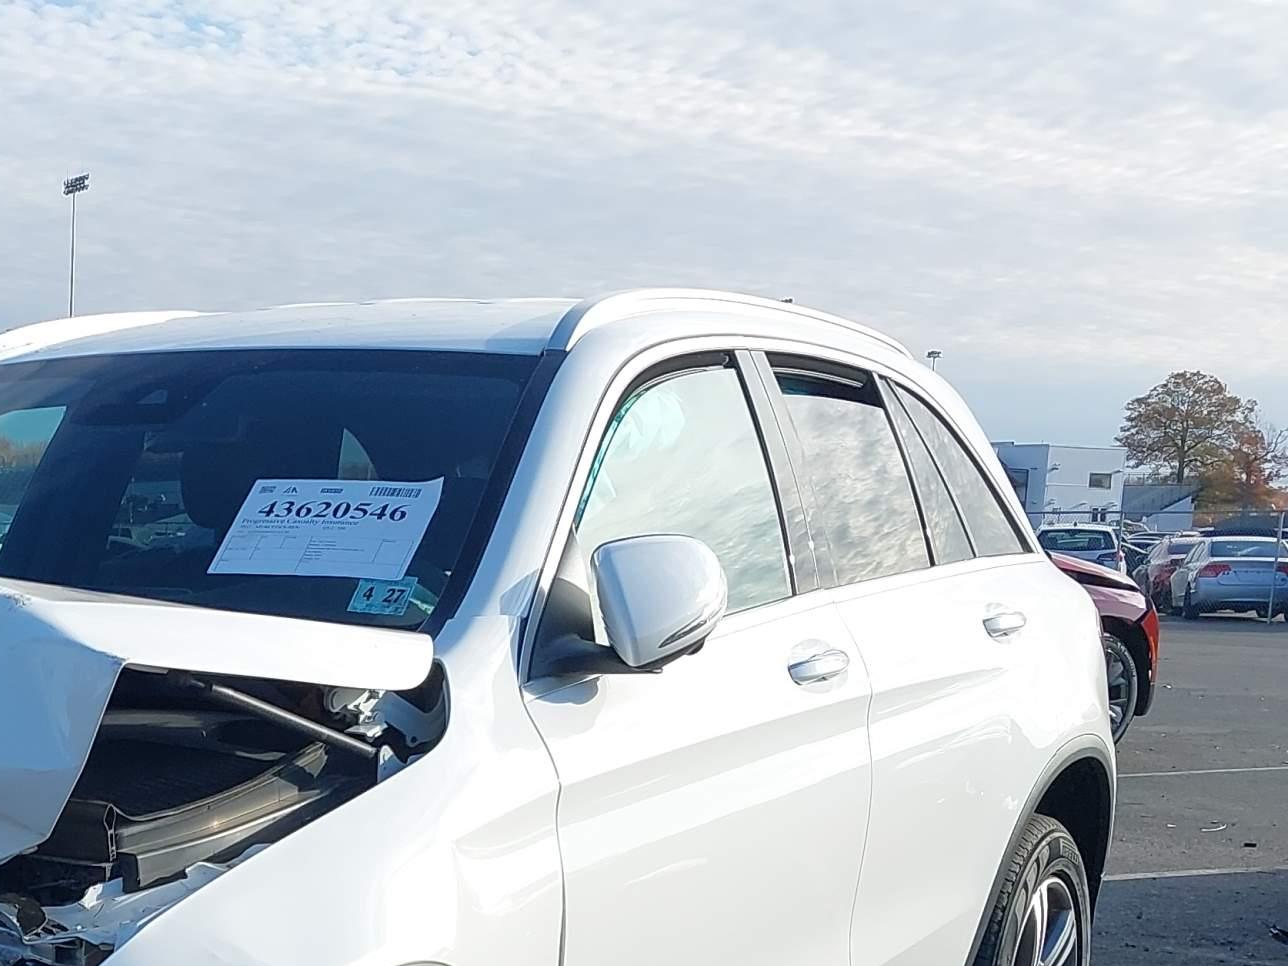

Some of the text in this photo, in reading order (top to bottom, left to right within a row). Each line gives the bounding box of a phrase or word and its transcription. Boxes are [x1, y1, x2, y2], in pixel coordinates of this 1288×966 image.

[257, 500, 412, 522] 43620546
[363, 586, 406, 603] 4 27
